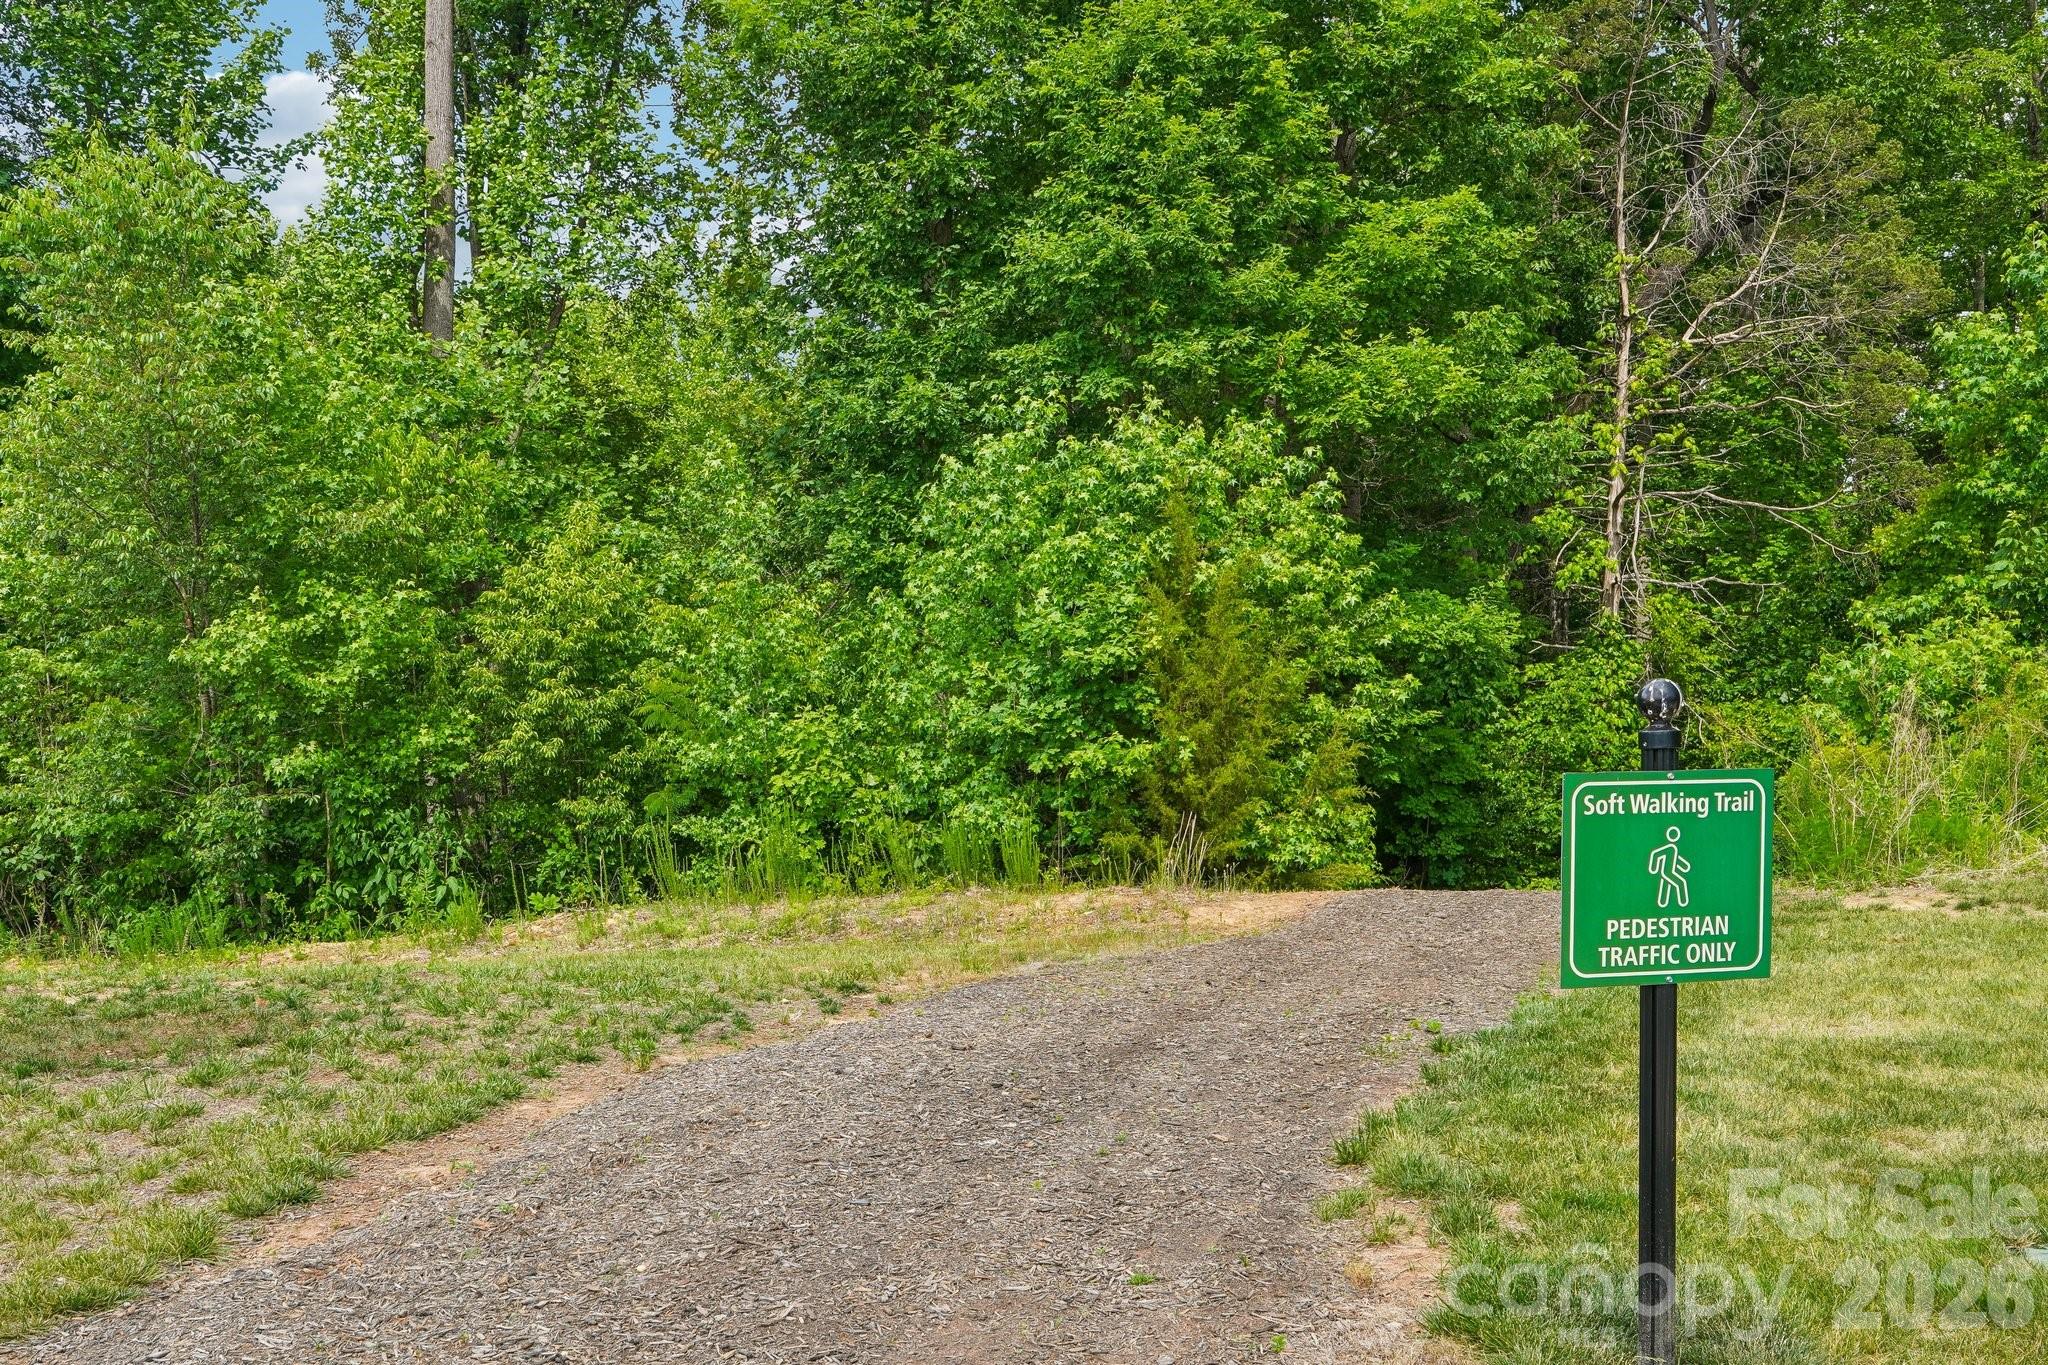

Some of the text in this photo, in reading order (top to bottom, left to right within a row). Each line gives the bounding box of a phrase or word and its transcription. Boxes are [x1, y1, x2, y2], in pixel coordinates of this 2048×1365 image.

[1583, 790, 1755, 819] Soft Walking Trail
[1606, 915, 1729, 940] PEDESTRIAN
[1598, 941, 1737, 968] TRAFFIC ONLY
